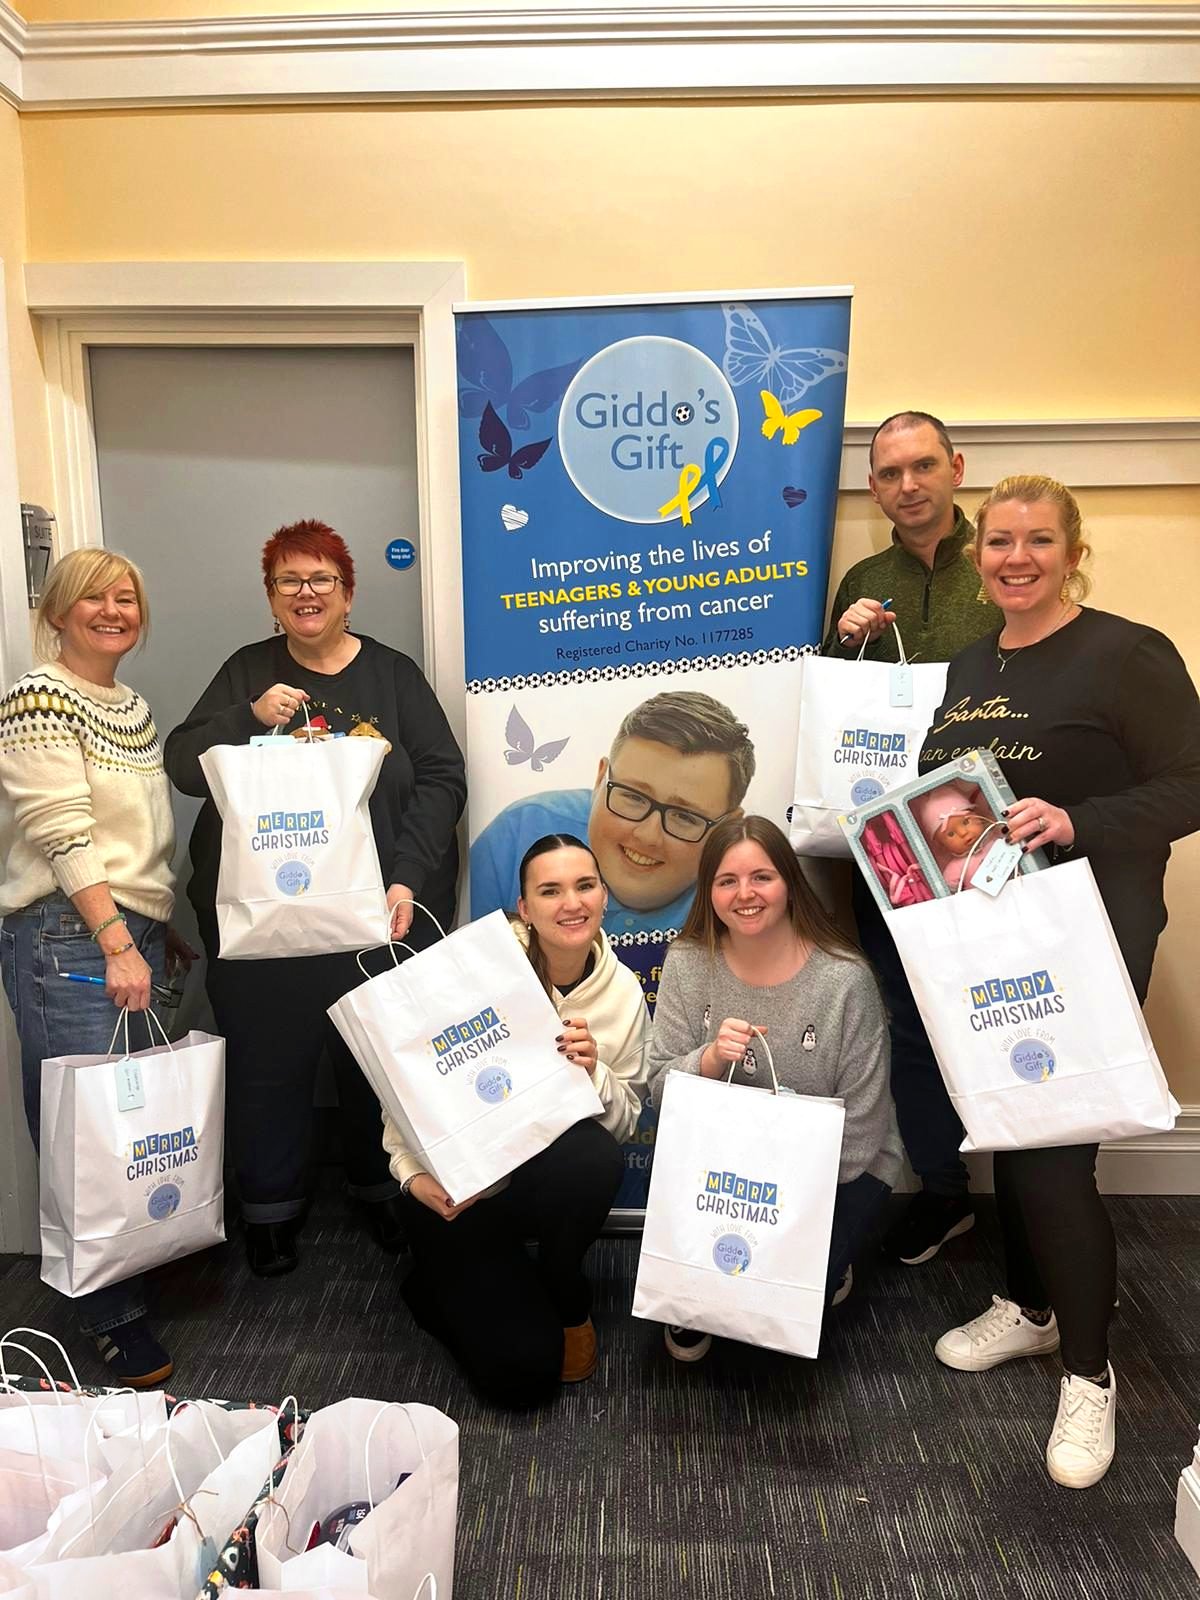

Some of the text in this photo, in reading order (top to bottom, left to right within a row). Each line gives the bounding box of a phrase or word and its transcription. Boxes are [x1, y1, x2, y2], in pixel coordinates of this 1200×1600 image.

[575, 388, 721, 430] Giddo's
[611, 434, 684, 471] Gift
[531, 530, 772, 581] Improving the lives of
[500, 560, 808, 610] TEENAGERS & YOUNG ADULTS
[539, 592, 774, 634] suffering from cancer
[556, 627, 754, 661] Registered Charity No. 1177285
[842, 729, 906, 752] MERRY
[834, 749, 908, 768] CHRISTMAS
[258, 811, 324, 833] MERRY
[252, 830, 329, 851] CHRISTMAS
[970, 970, 1055, 1010] MERRY
[970, 994, 1065, 1032] CHRISTMAS
[432, 1006, 500, 1057] MERRY
[436, 1023, 511, 1076] CHRISTMAS
[1014, 1049, 1050, 1064] Giddo's
[1025, 1061, 1044, 1072] Gift
[133, 1126, 196, 1162] MERRY
[127, 1146, 198, 1181] CHRISTMAS
[705, 1171, 777, 1206] MERRY
[696, 1194, 779, 1225] CHRISTMAS
[717, 1243, 749, 1257] Giddo's
[723, 1254, 739, 1265] Gift
